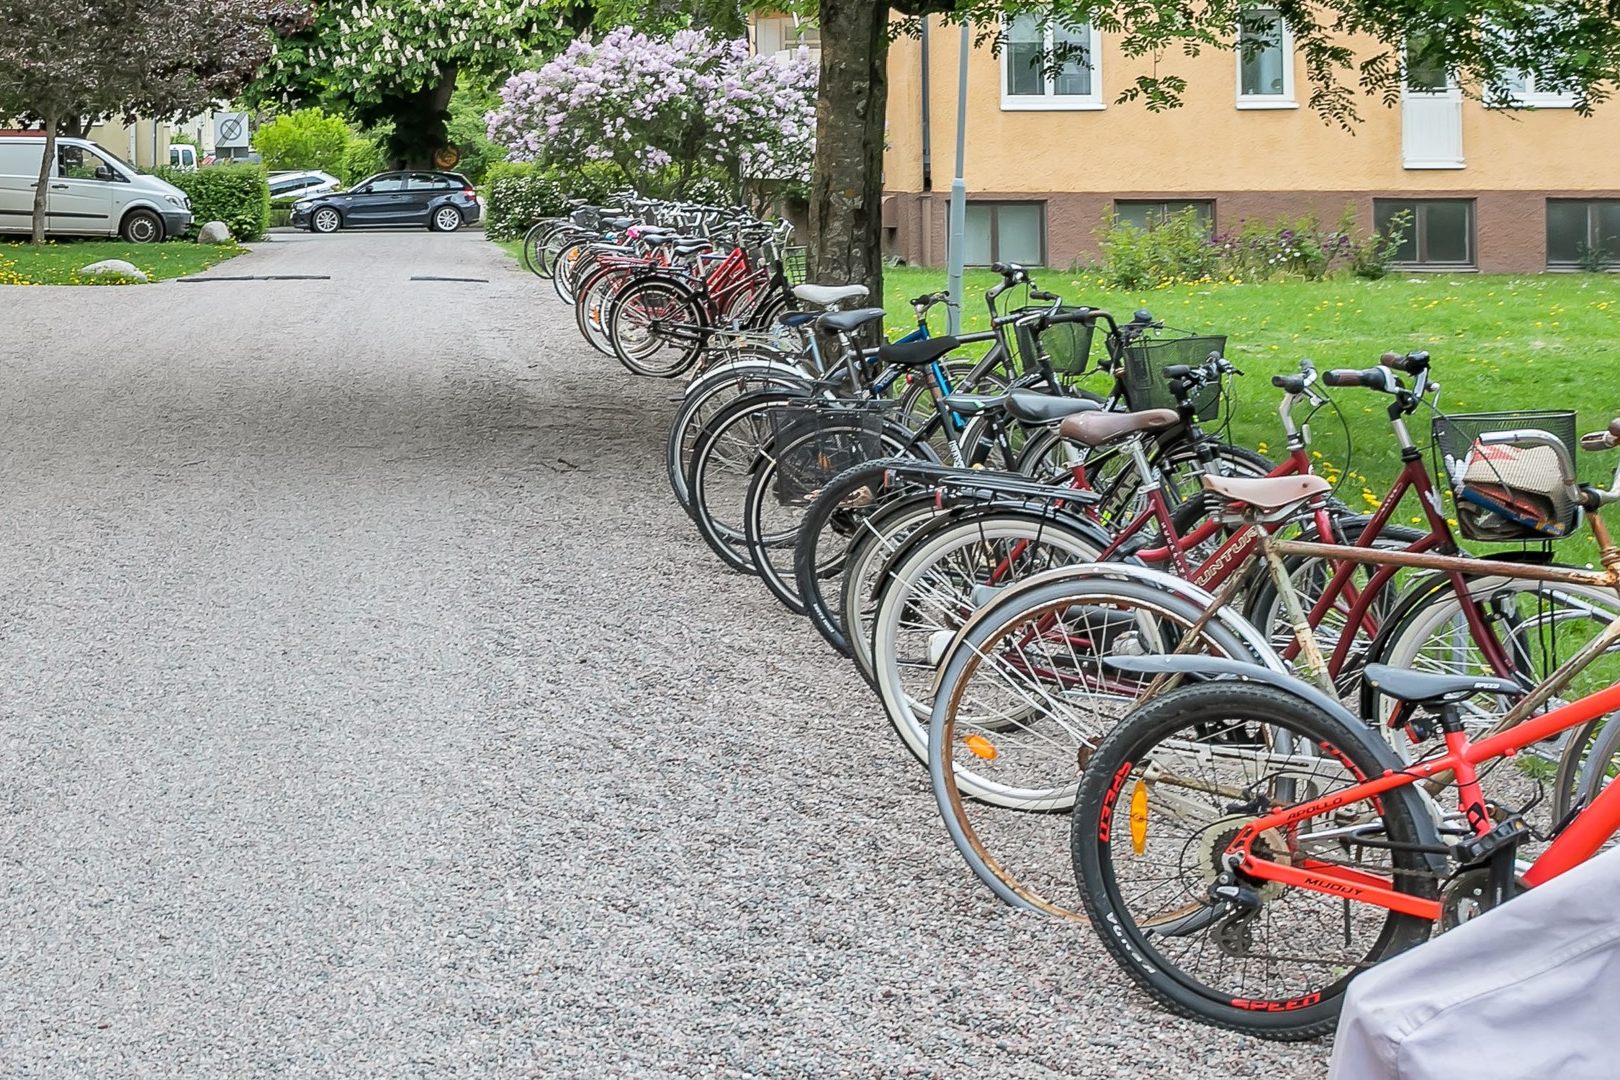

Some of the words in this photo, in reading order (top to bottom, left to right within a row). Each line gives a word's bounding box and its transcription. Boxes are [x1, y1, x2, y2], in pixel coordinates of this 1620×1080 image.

[1194, 524, 1258, 587] UNTUR
[1099, 761, 1132, 843] SPEED
[1287, 798, 1342, 821] APOLLO
[1230, 992, 1321, 1012] SPEED
